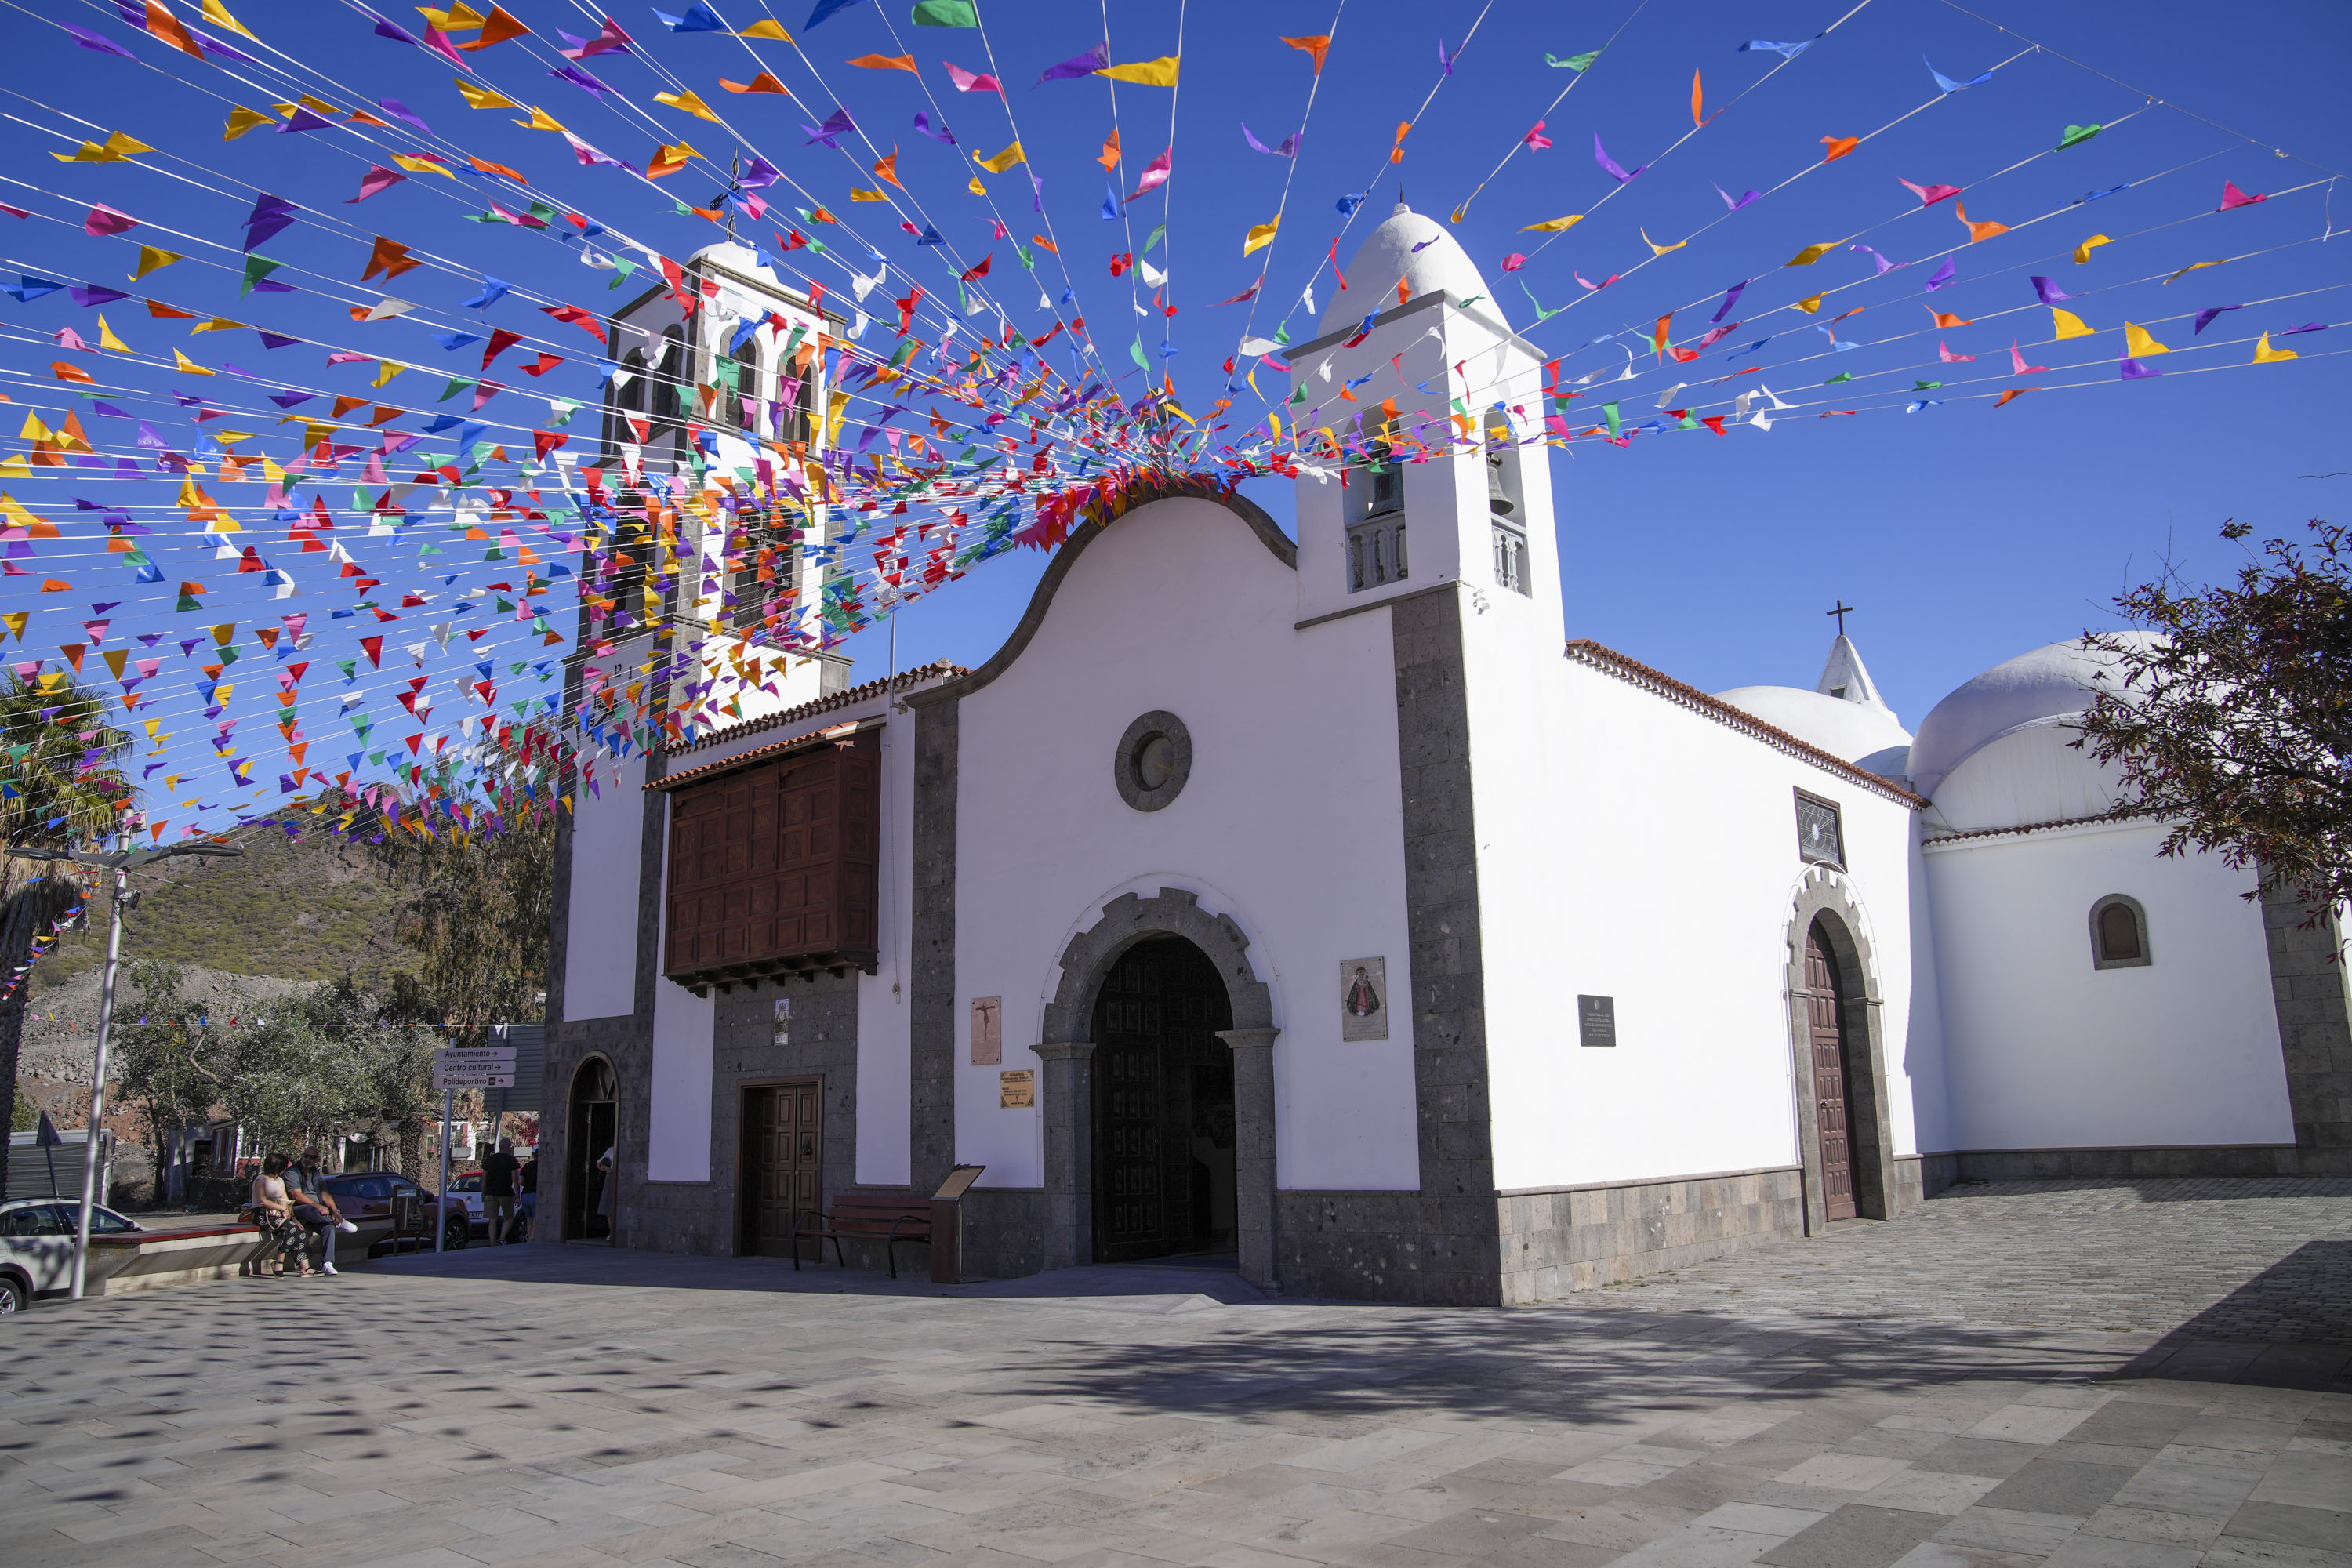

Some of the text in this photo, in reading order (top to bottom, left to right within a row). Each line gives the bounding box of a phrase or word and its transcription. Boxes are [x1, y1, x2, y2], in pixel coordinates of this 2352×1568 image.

[614, 663, 622, 678] 12
[445, 1051, 490, 1059] Ayuntamiento
[443, 1077, 487, 1087] Polideportivo
